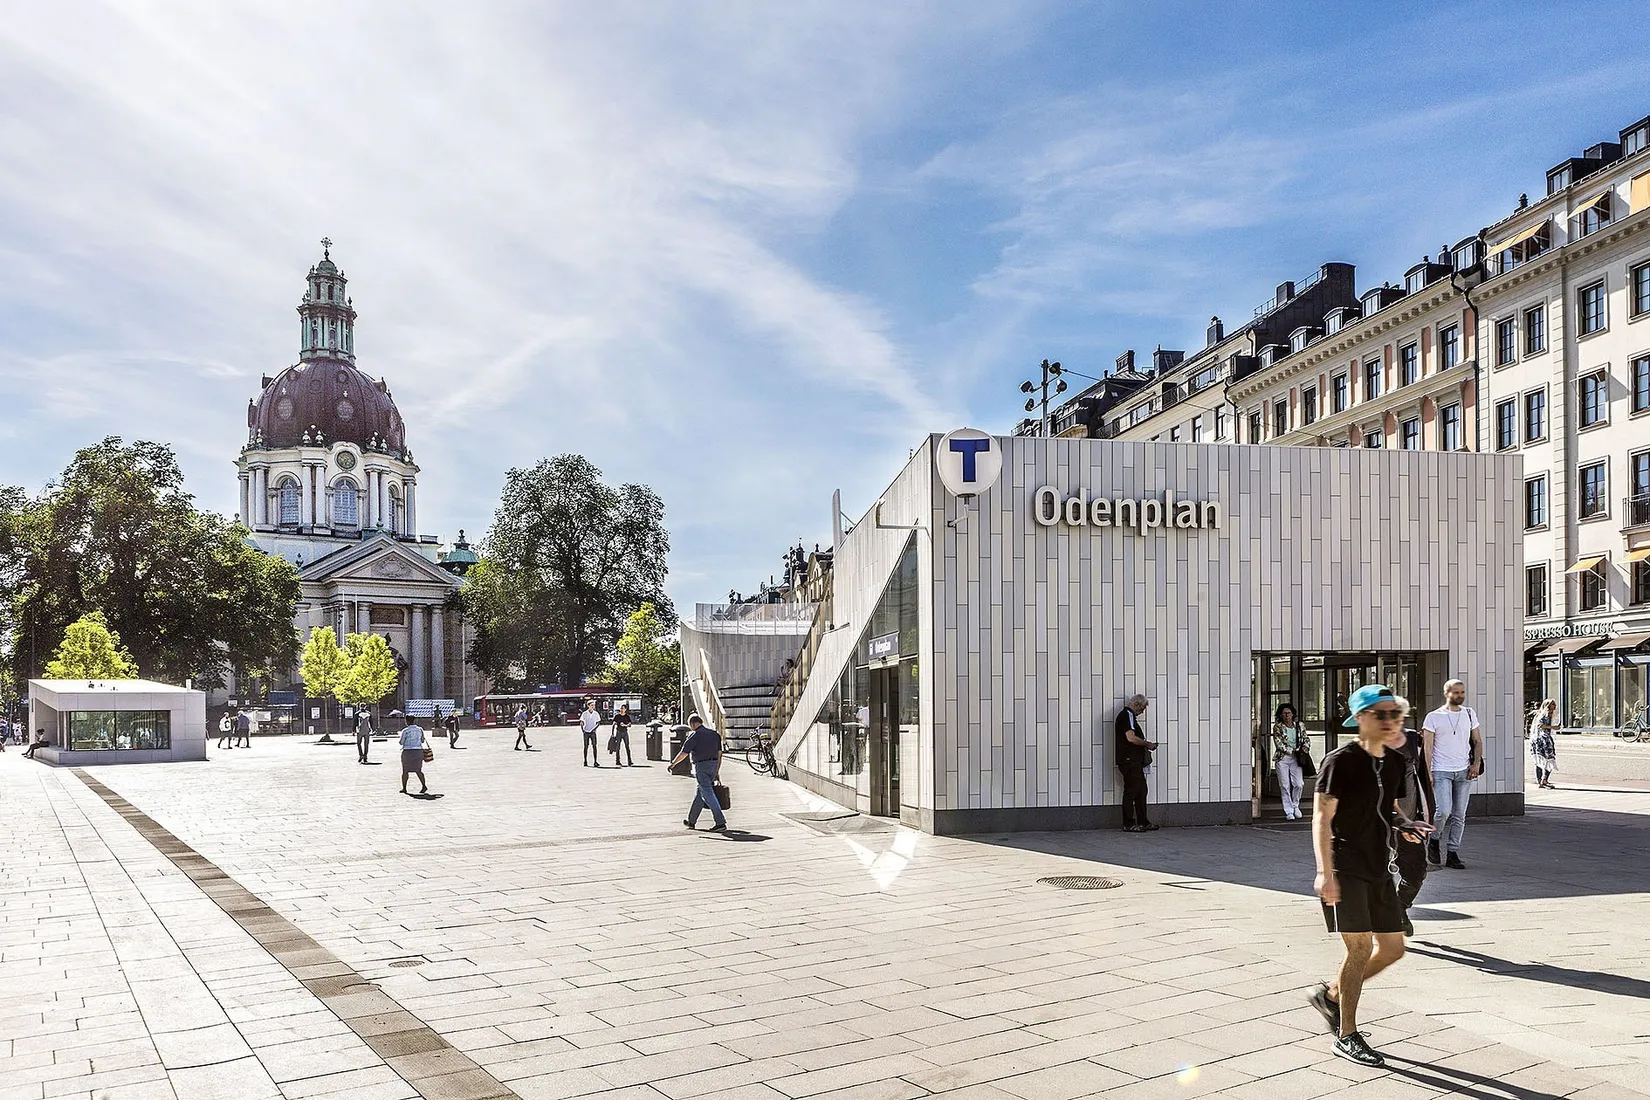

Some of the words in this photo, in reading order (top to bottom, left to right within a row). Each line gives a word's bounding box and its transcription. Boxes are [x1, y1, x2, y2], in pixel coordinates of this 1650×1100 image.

[949, 437, 990, 483] T
[1034, 485, 1222, 537] Odenplan
[1525, 625, 1571, 640] SPRESSO
